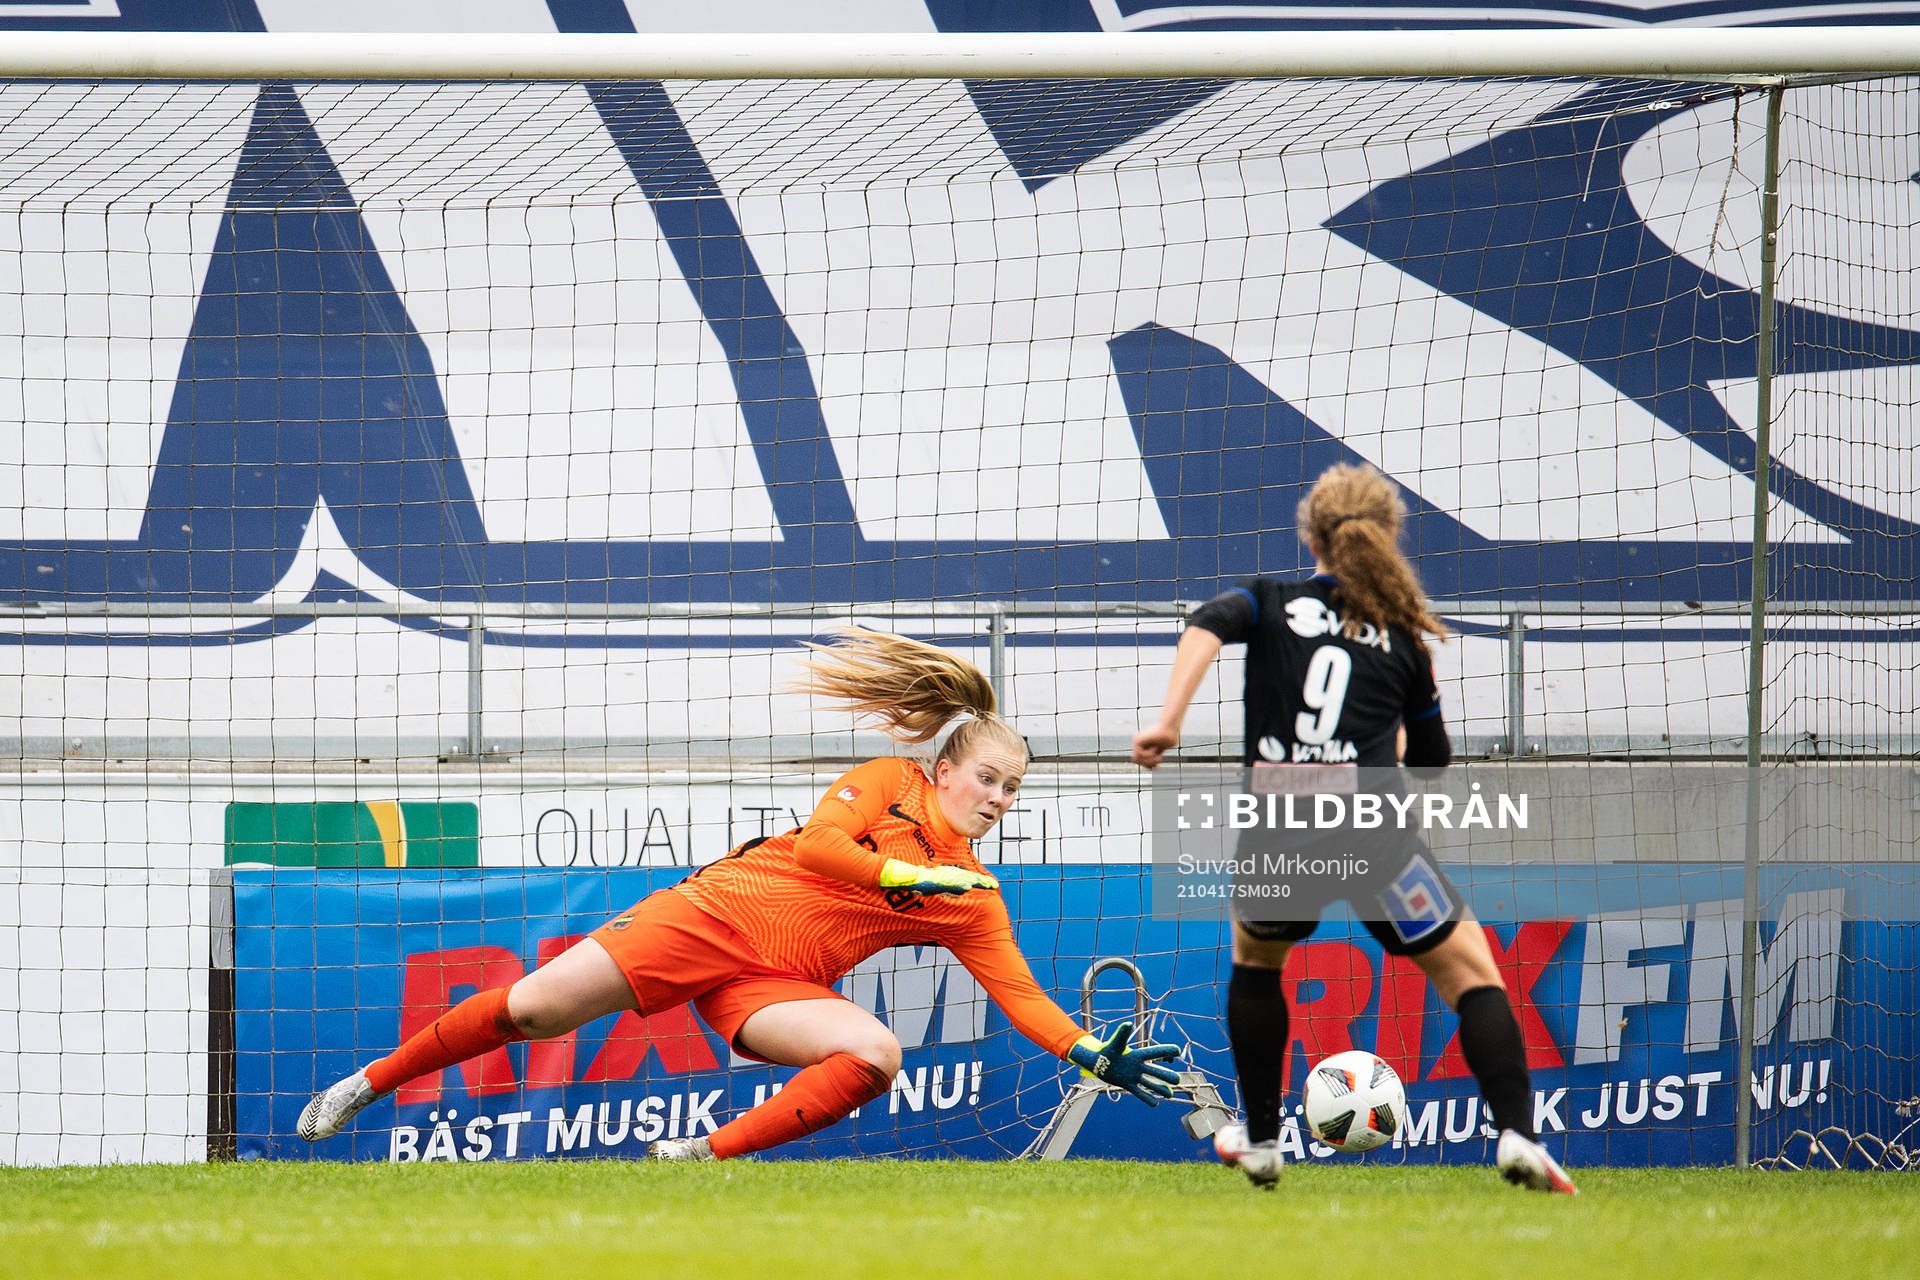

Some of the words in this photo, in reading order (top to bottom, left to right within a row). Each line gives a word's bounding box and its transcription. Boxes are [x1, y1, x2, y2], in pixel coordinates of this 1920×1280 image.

[1294, 644, 1353, 746] 9
[389, 1109, 532, 1163] BÄST
[546, 1089, 725, 1153] MUSIK
[888, 1061, 984, 1115] NU!
[1581, 1071, 1722, 1129] JUST
[1737, 1059, 1831, 1113] NU!
